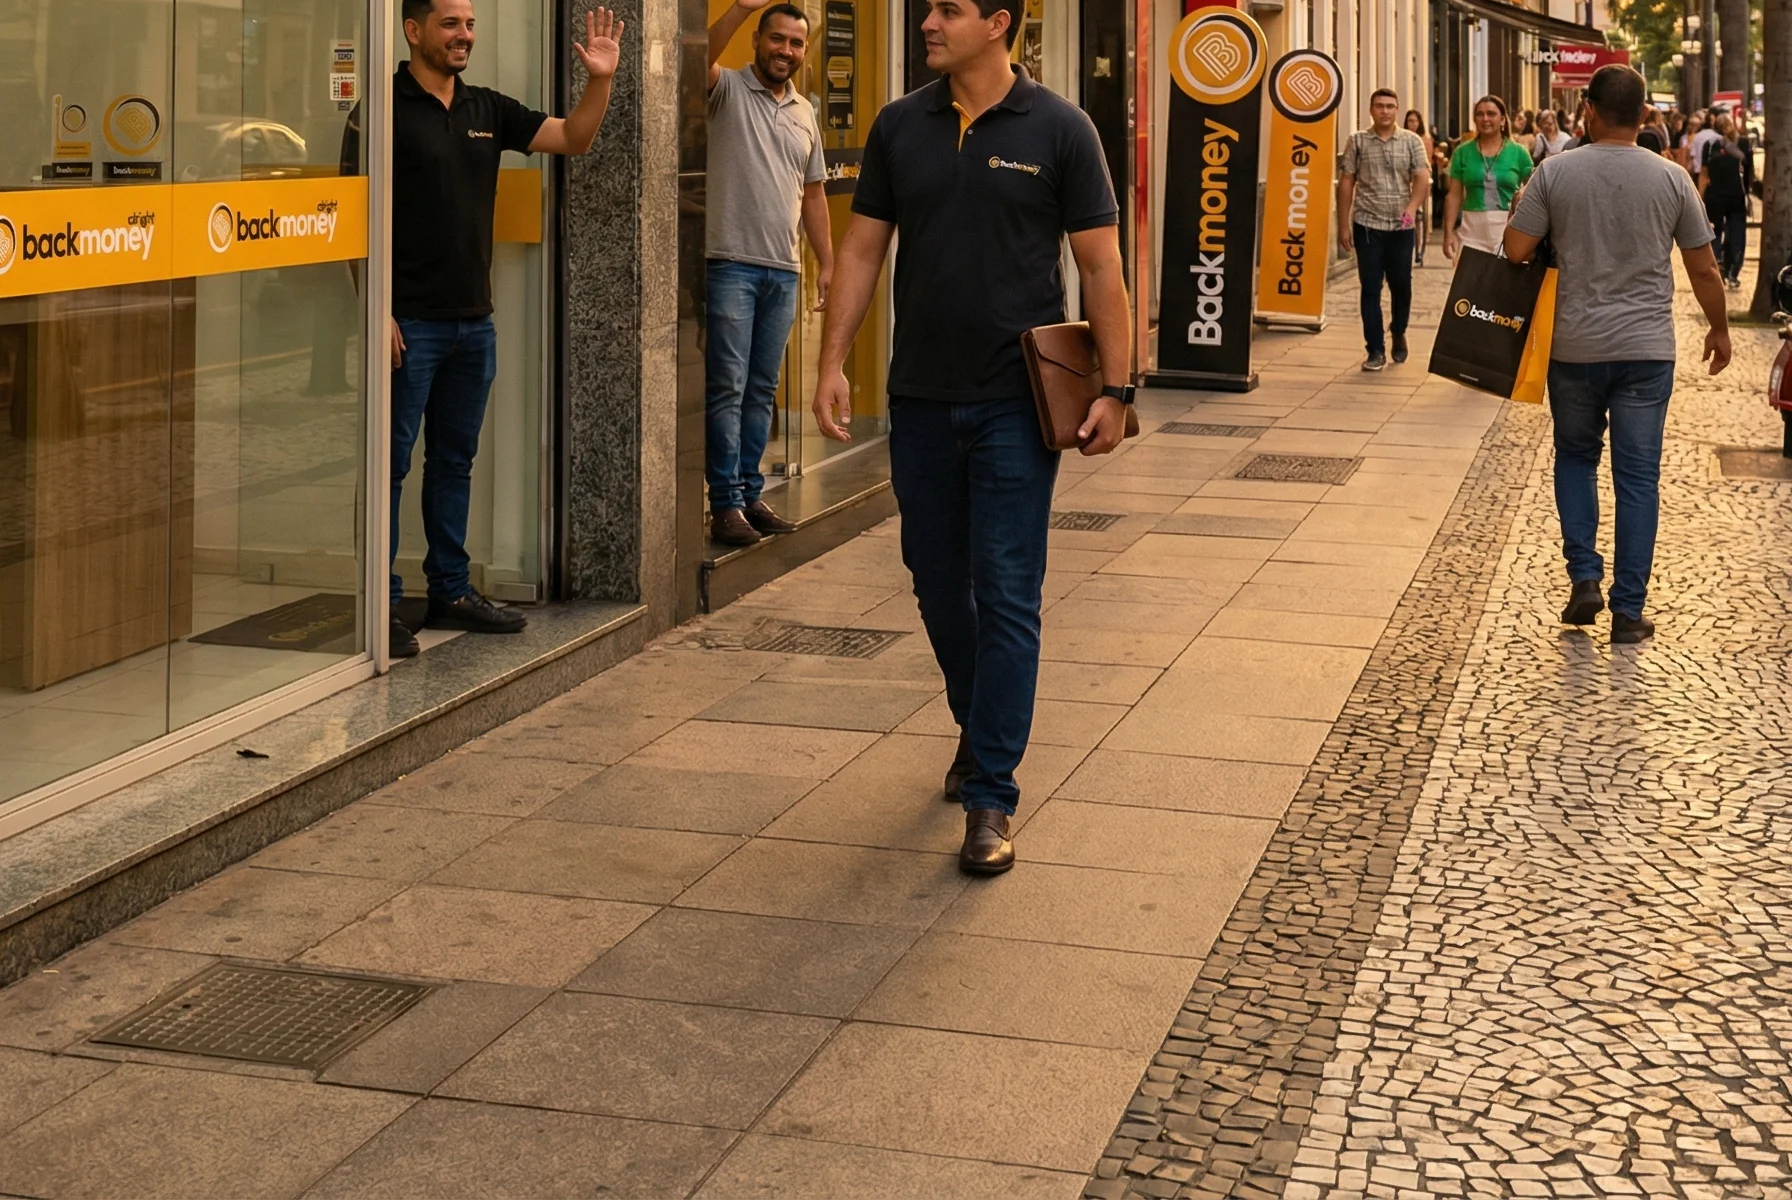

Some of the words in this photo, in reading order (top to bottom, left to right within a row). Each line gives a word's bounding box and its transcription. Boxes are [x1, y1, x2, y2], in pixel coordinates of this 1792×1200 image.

[22, 221, 155, 261] backmoney
[236, 208, 338, 243] backmoney
[1187, 117, 1240, 347] Backmoney
[1277, 133, 1319, 297] Backmoney
